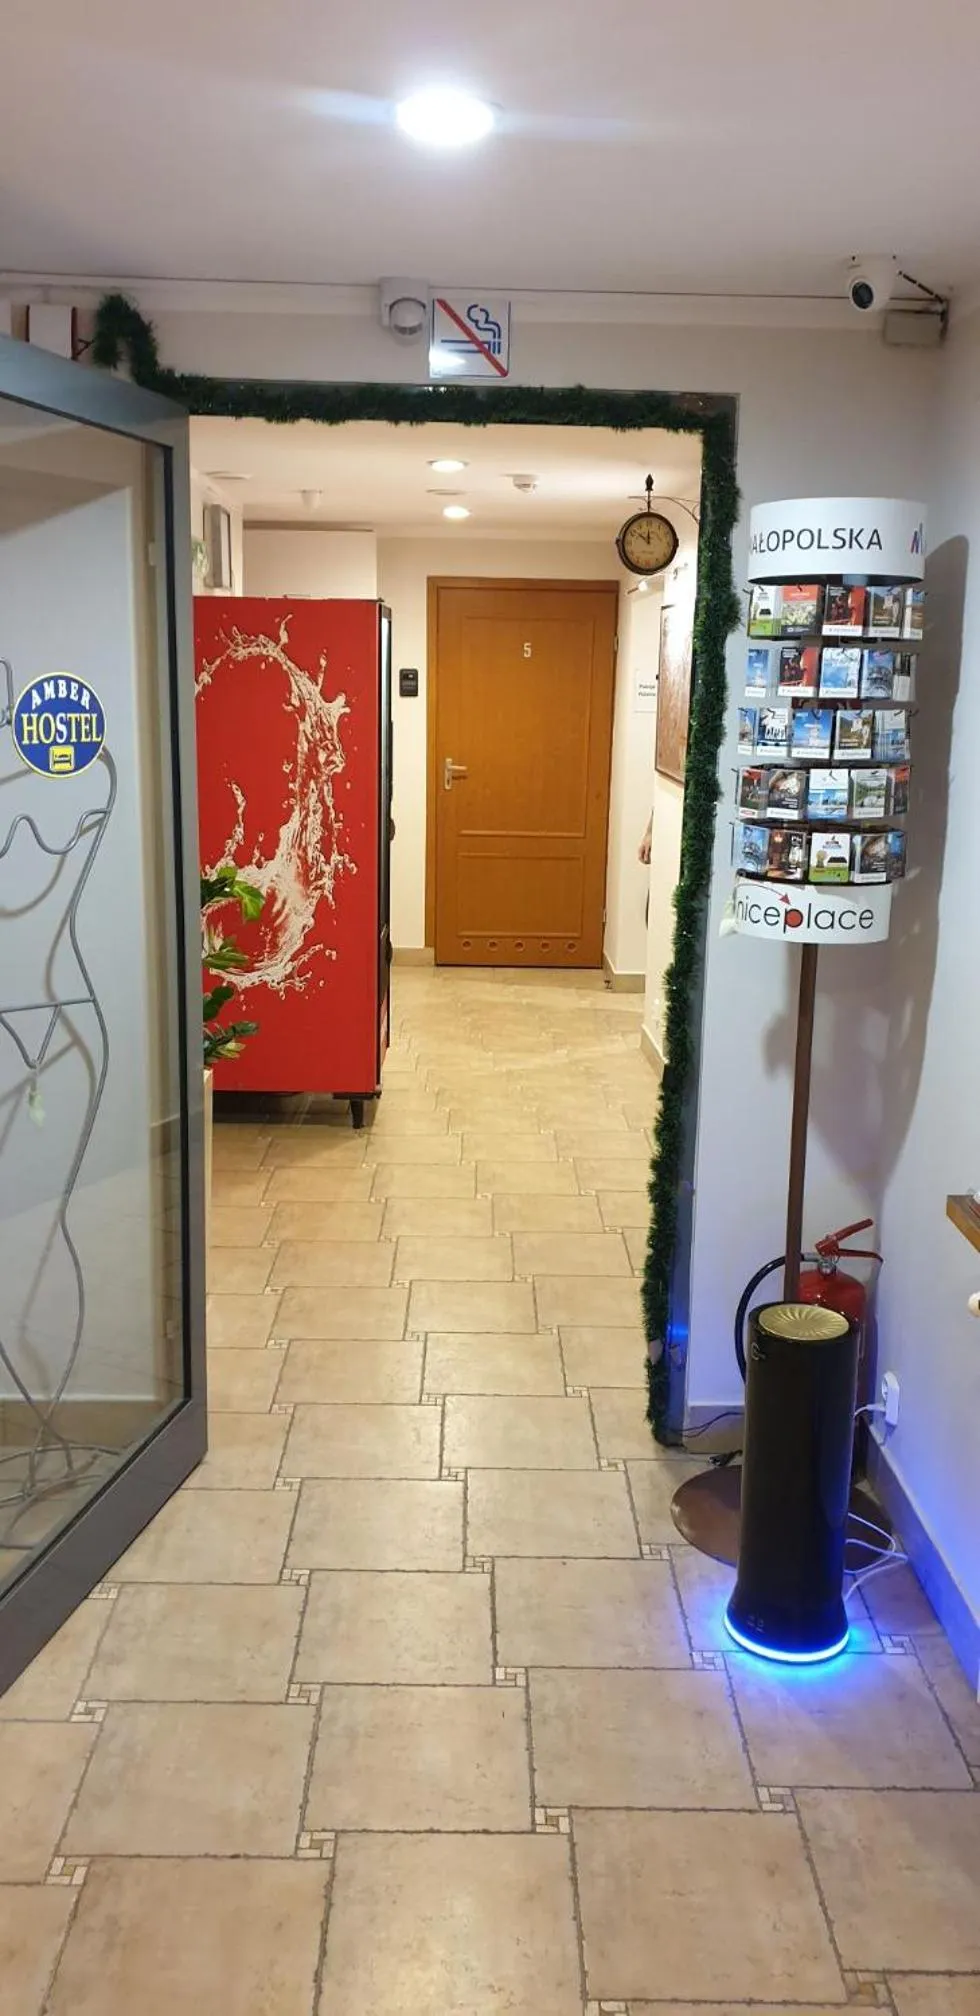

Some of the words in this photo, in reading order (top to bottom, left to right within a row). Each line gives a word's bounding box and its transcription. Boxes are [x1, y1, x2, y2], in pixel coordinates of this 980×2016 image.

[750, 528, 883, 554] AŁOPOLSKA
[523, 642, 532, 658] 5
[31, 679, 91, 710] AMBER
[21, 712, 102, 745] HOSTEL
